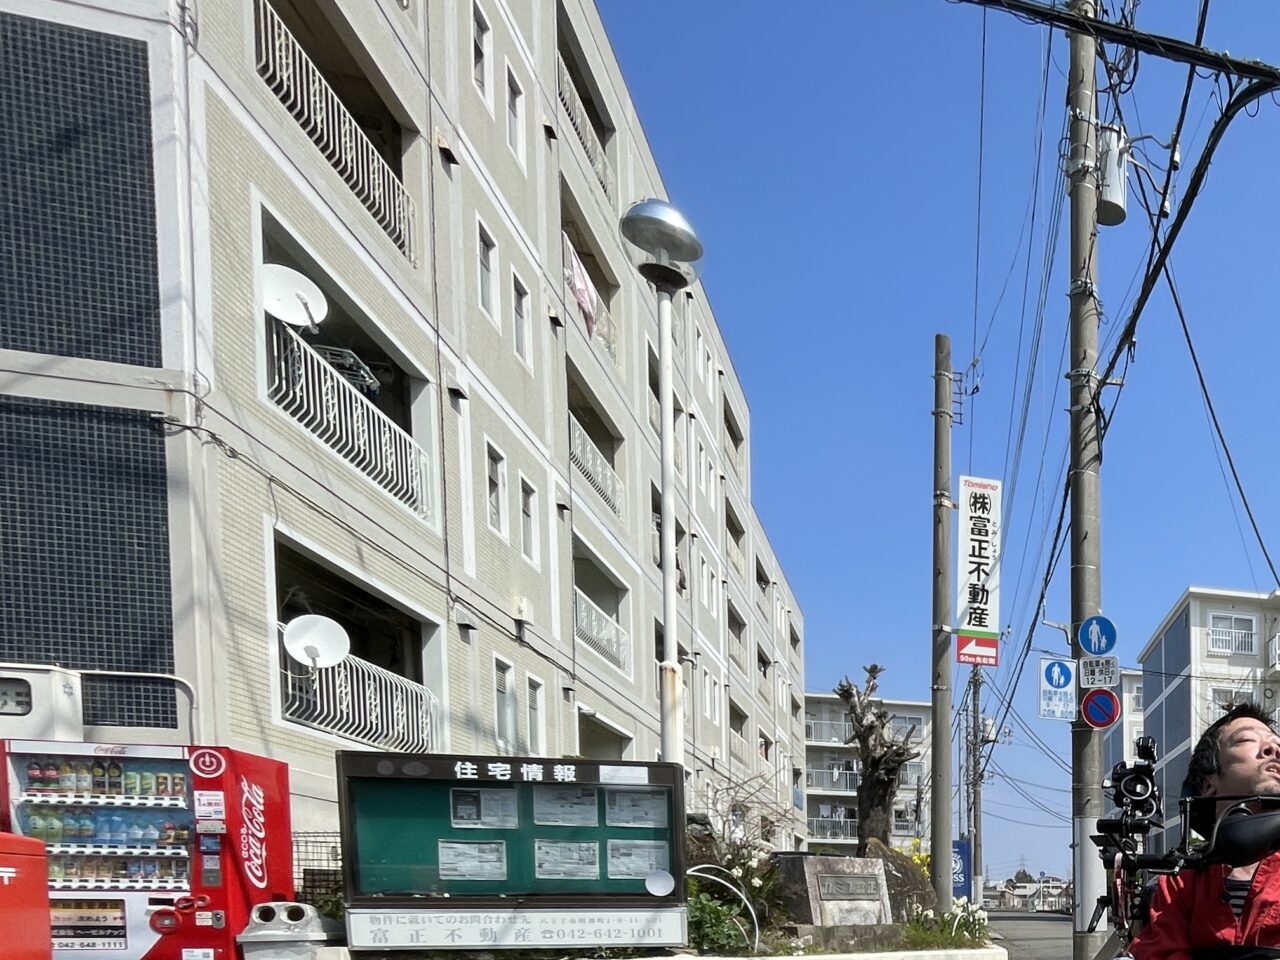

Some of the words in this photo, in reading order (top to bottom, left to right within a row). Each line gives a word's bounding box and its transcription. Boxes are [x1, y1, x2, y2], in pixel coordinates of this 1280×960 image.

[963, 480, 998, 491] Tomisho
[454, 760, 577, 783] 住宅情報
[241, 774, 268, 889] Coca-Cola
